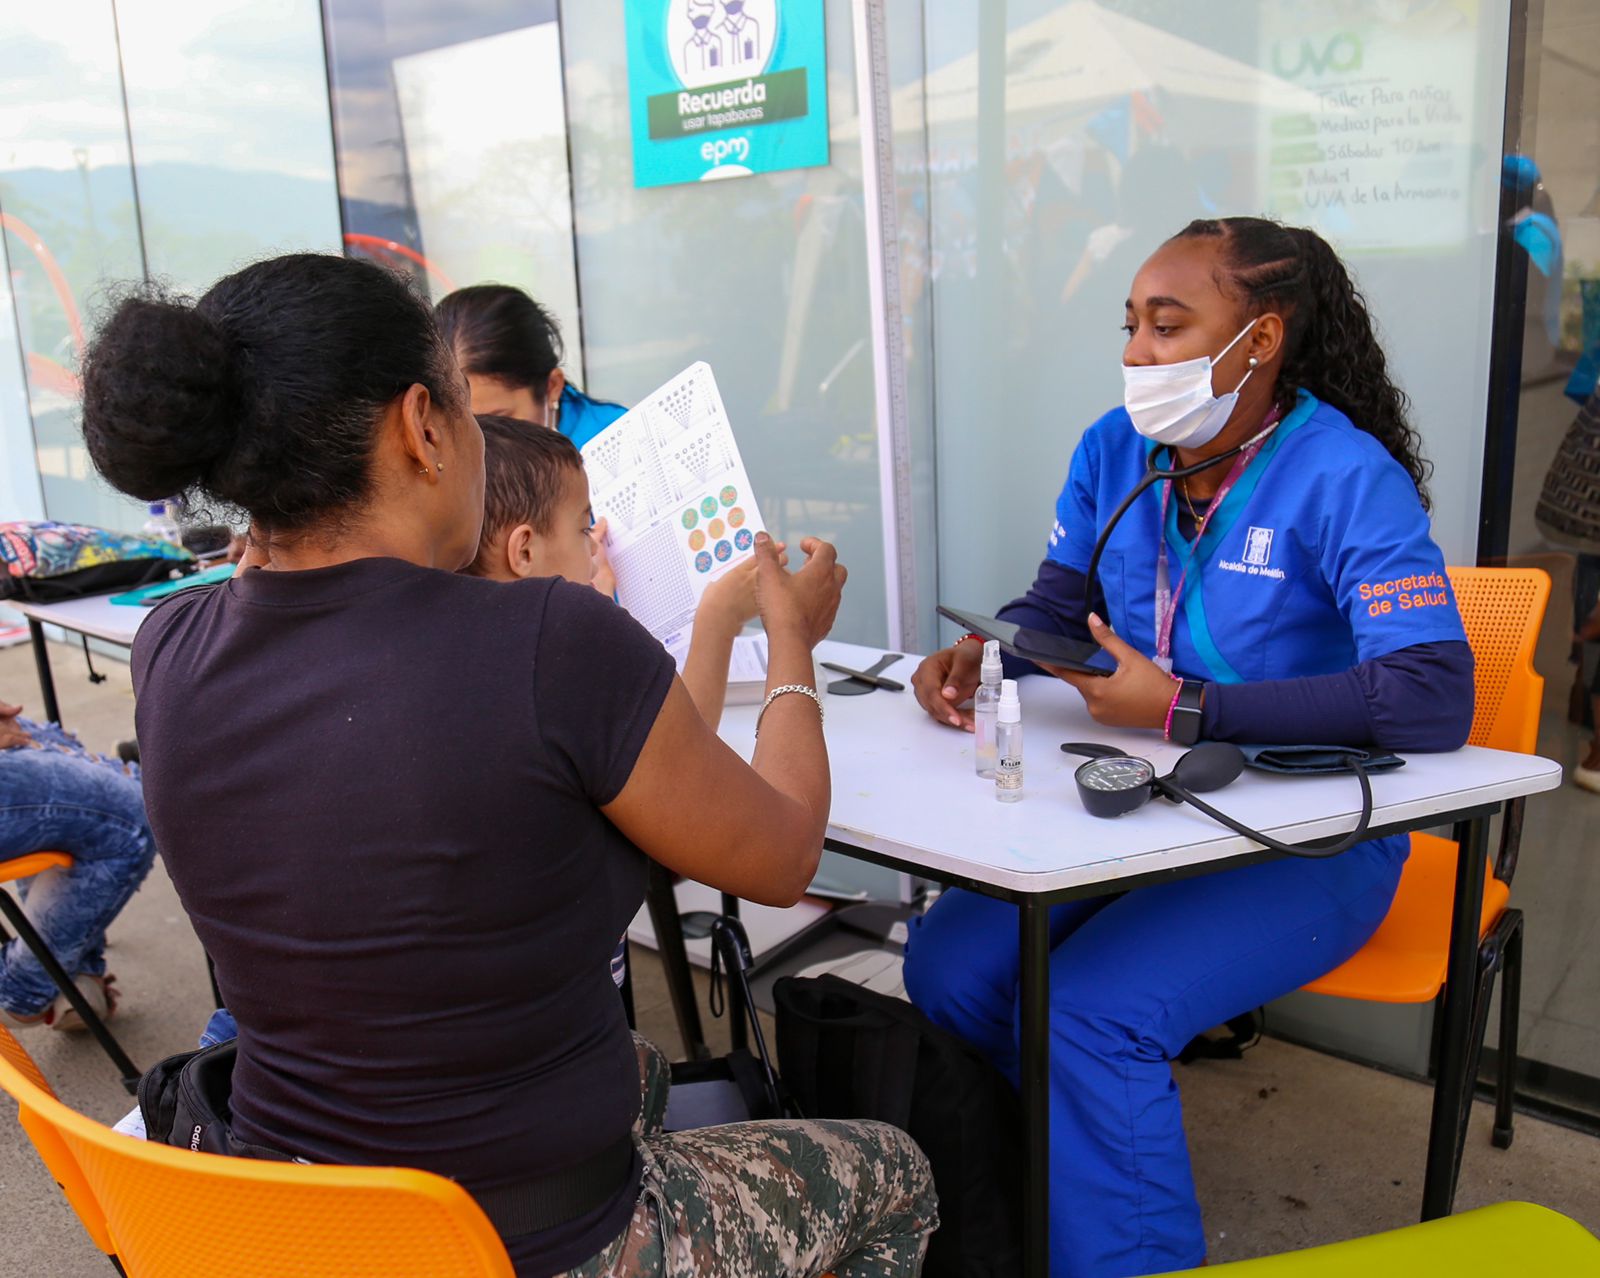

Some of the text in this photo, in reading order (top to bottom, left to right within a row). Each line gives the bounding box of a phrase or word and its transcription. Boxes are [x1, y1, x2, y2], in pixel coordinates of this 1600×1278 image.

[678, 79, 767, 116] Recuerda
[683, 106, 765, 131] usar tapabocas
[700, 136, 750, 166] epm
[1248, 565, 1259, 575] de
[1368, 590, 1448, 617] de Salud
[190, 1125, 202, 1152] adid
